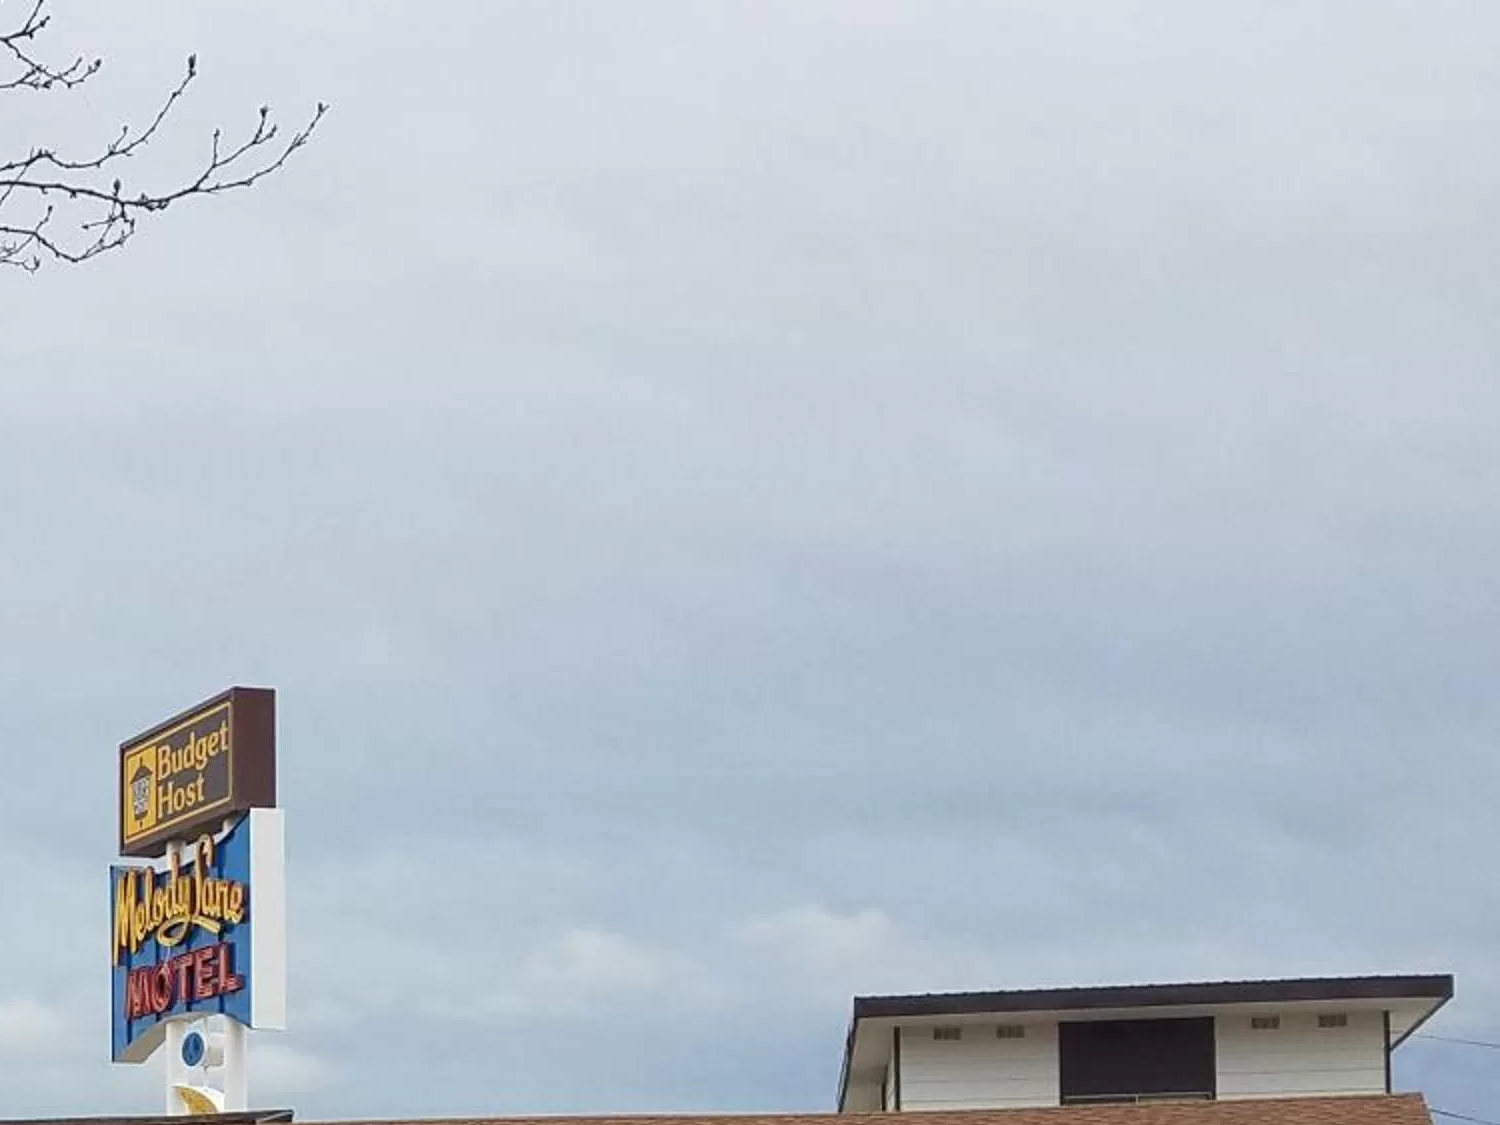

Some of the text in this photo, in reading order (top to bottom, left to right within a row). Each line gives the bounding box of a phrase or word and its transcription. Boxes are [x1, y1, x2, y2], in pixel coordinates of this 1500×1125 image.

[158, 720, 228, 780] Budget
[158, 775, 204, 818] Host
[114, 834, 245, 966] Melody Lane
[126, 945, 243, 1020] MOTEL
